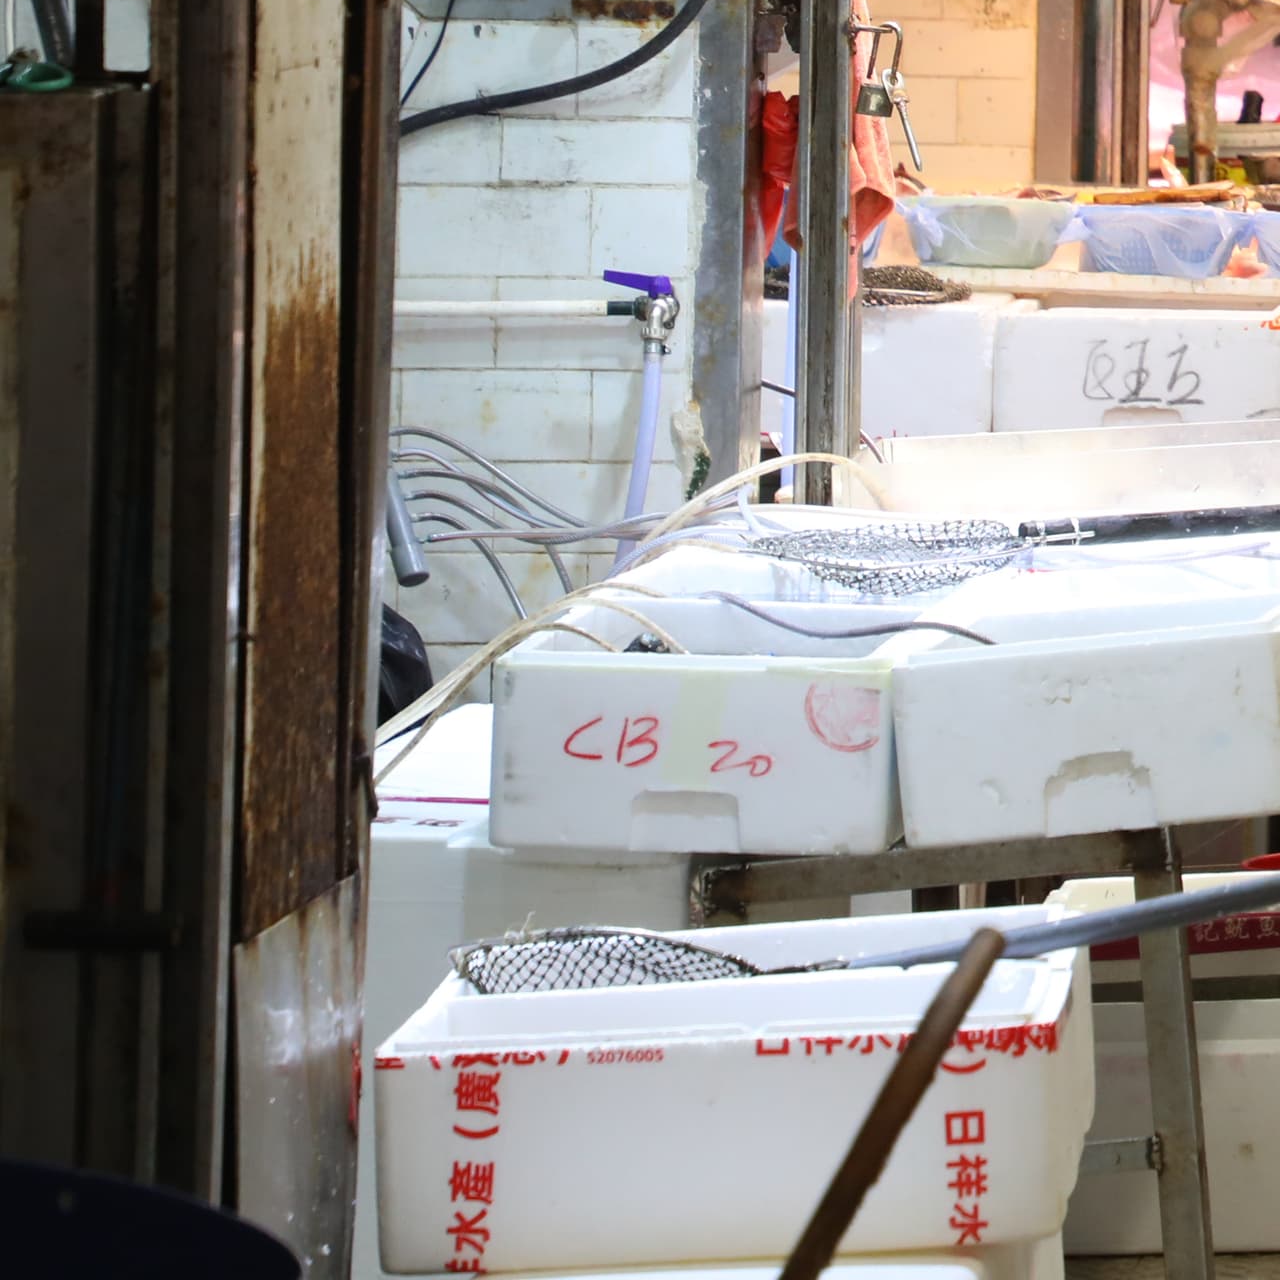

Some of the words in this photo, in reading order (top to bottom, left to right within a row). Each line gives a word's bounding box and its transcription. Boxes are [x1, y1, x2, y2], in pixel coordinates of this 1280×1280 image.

[563, 717, 659, 768] CB
[708, 740, 773, 777] 20
[586, 1048, 665, 1065] 52076005
